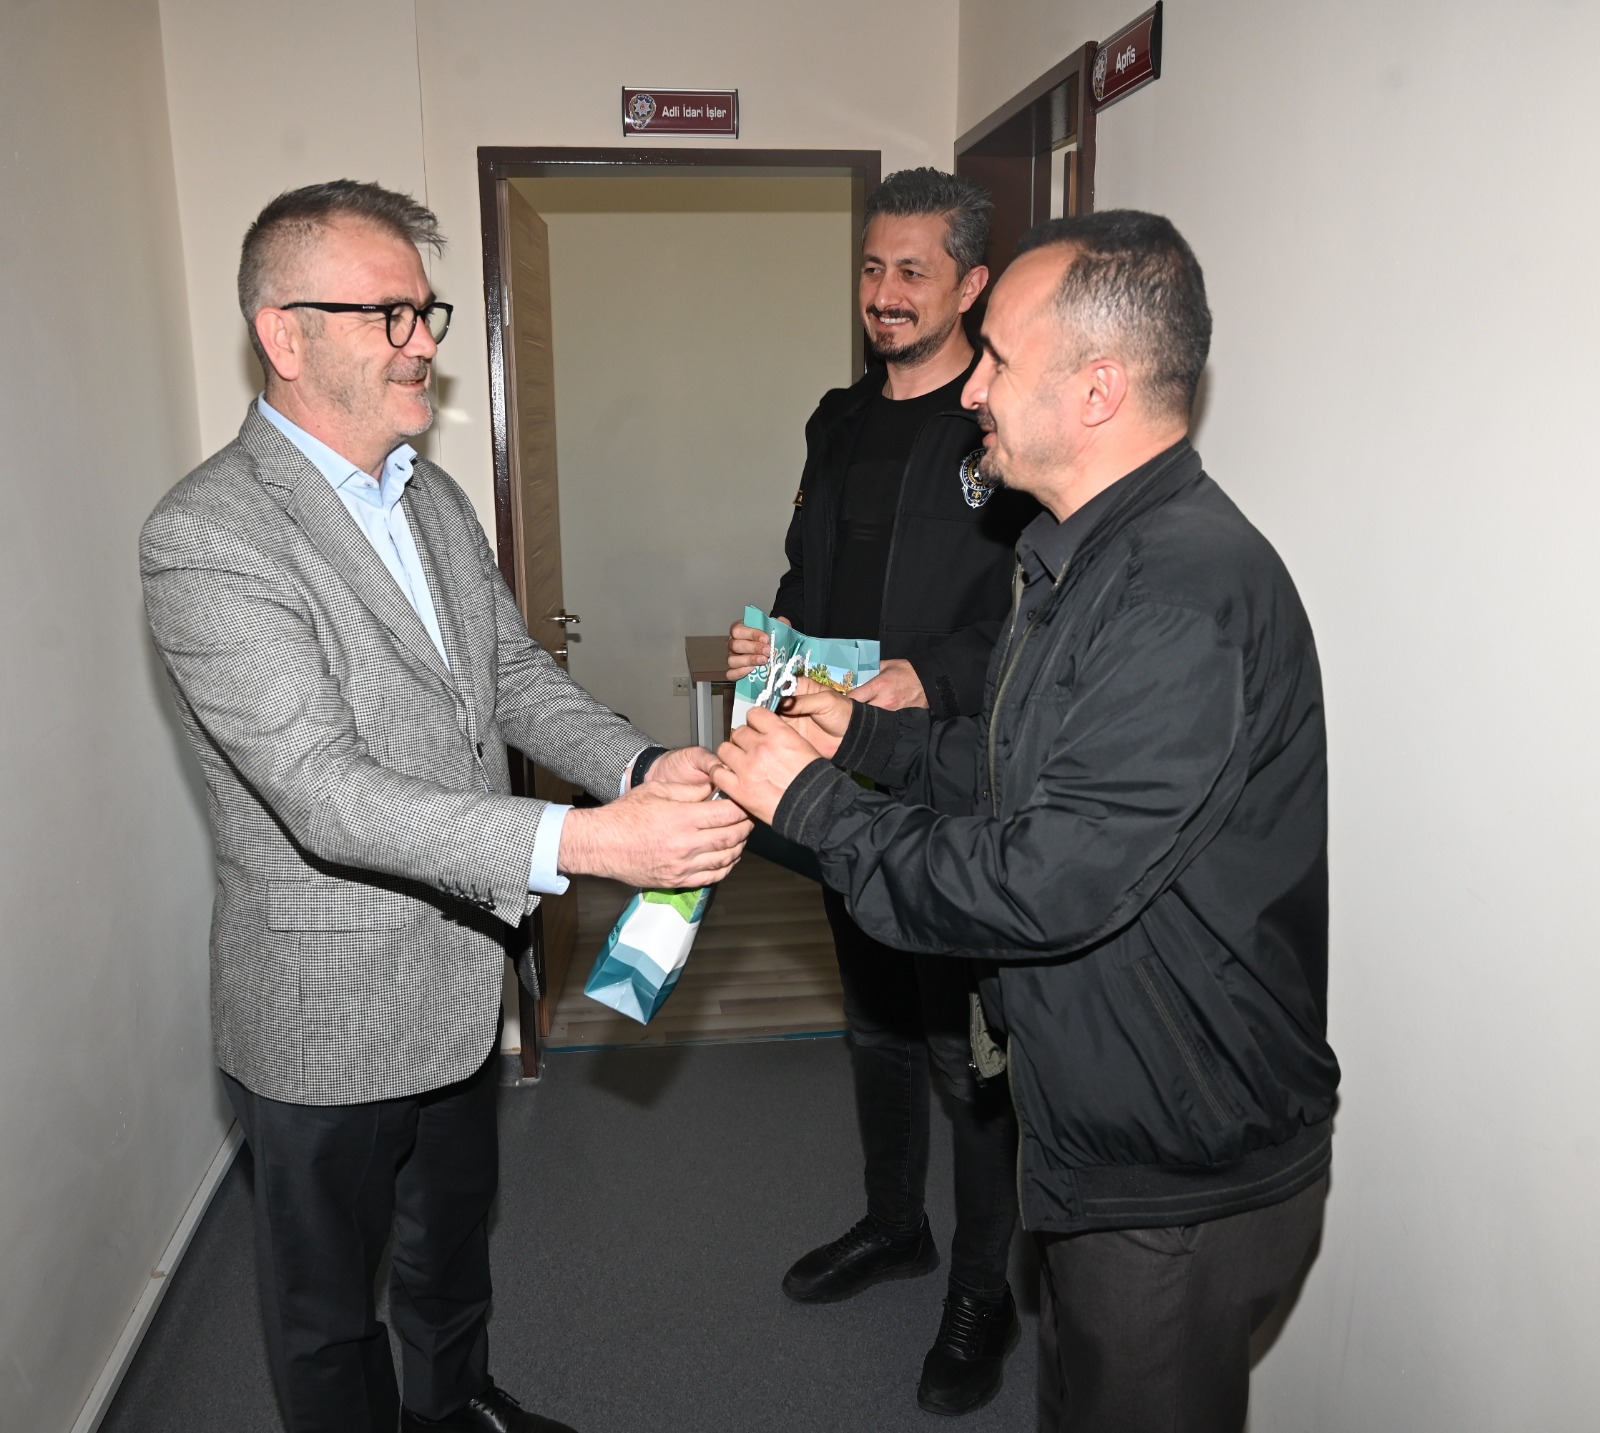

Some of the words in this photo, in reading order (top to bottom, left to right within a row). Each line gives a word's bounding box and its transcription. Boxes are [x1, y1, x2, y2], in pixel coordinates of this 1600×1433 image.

[1115, 44, 1136, 74] Apfis
[661, 105, 680, 118] Adli
[682, 104, 703, 118] İdari
[706, 104, 727, 120] İşler
